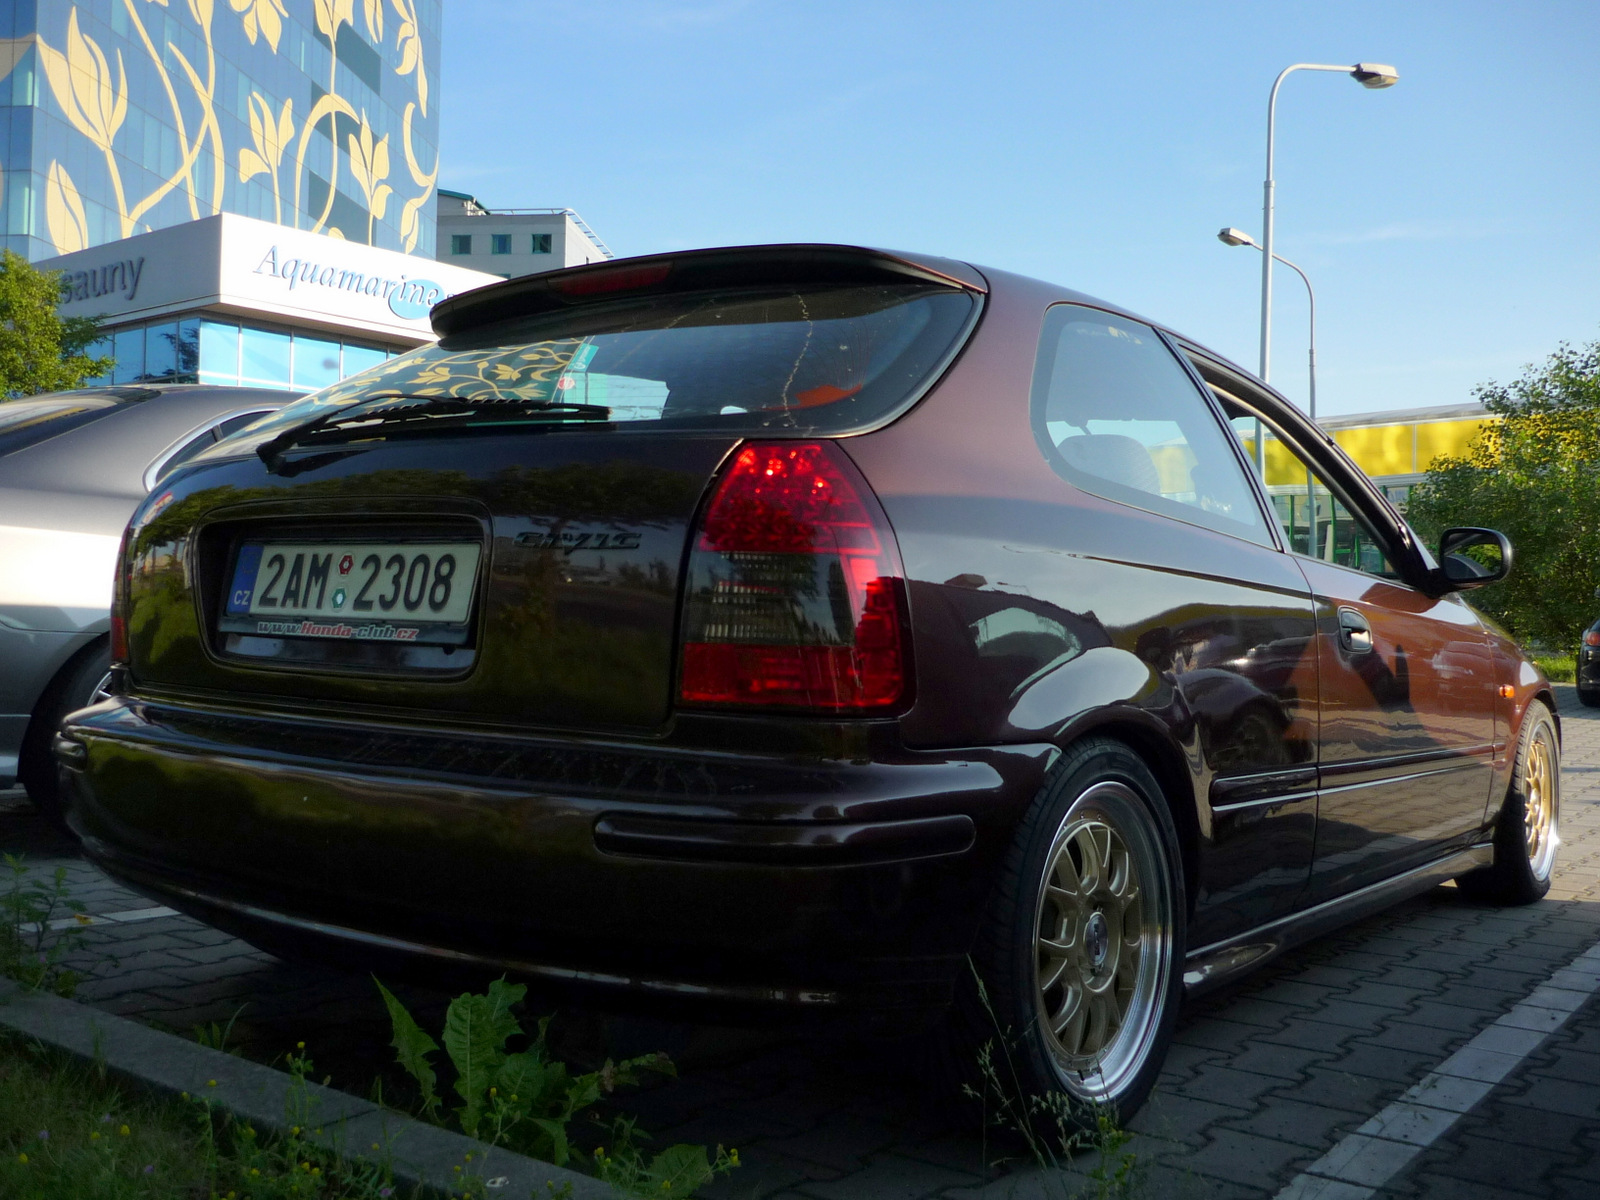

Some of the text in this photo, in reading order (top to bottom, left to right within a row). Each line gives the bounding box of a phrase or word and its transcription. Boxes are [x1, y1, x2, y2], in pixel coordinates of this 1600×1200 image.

[59, 256, 145, 304] sauny
[252, 245, 440, 306] Aquamarine
[233, 590, 251, 606] CZ
[258, 552, 456, 613] 2AM 2308
